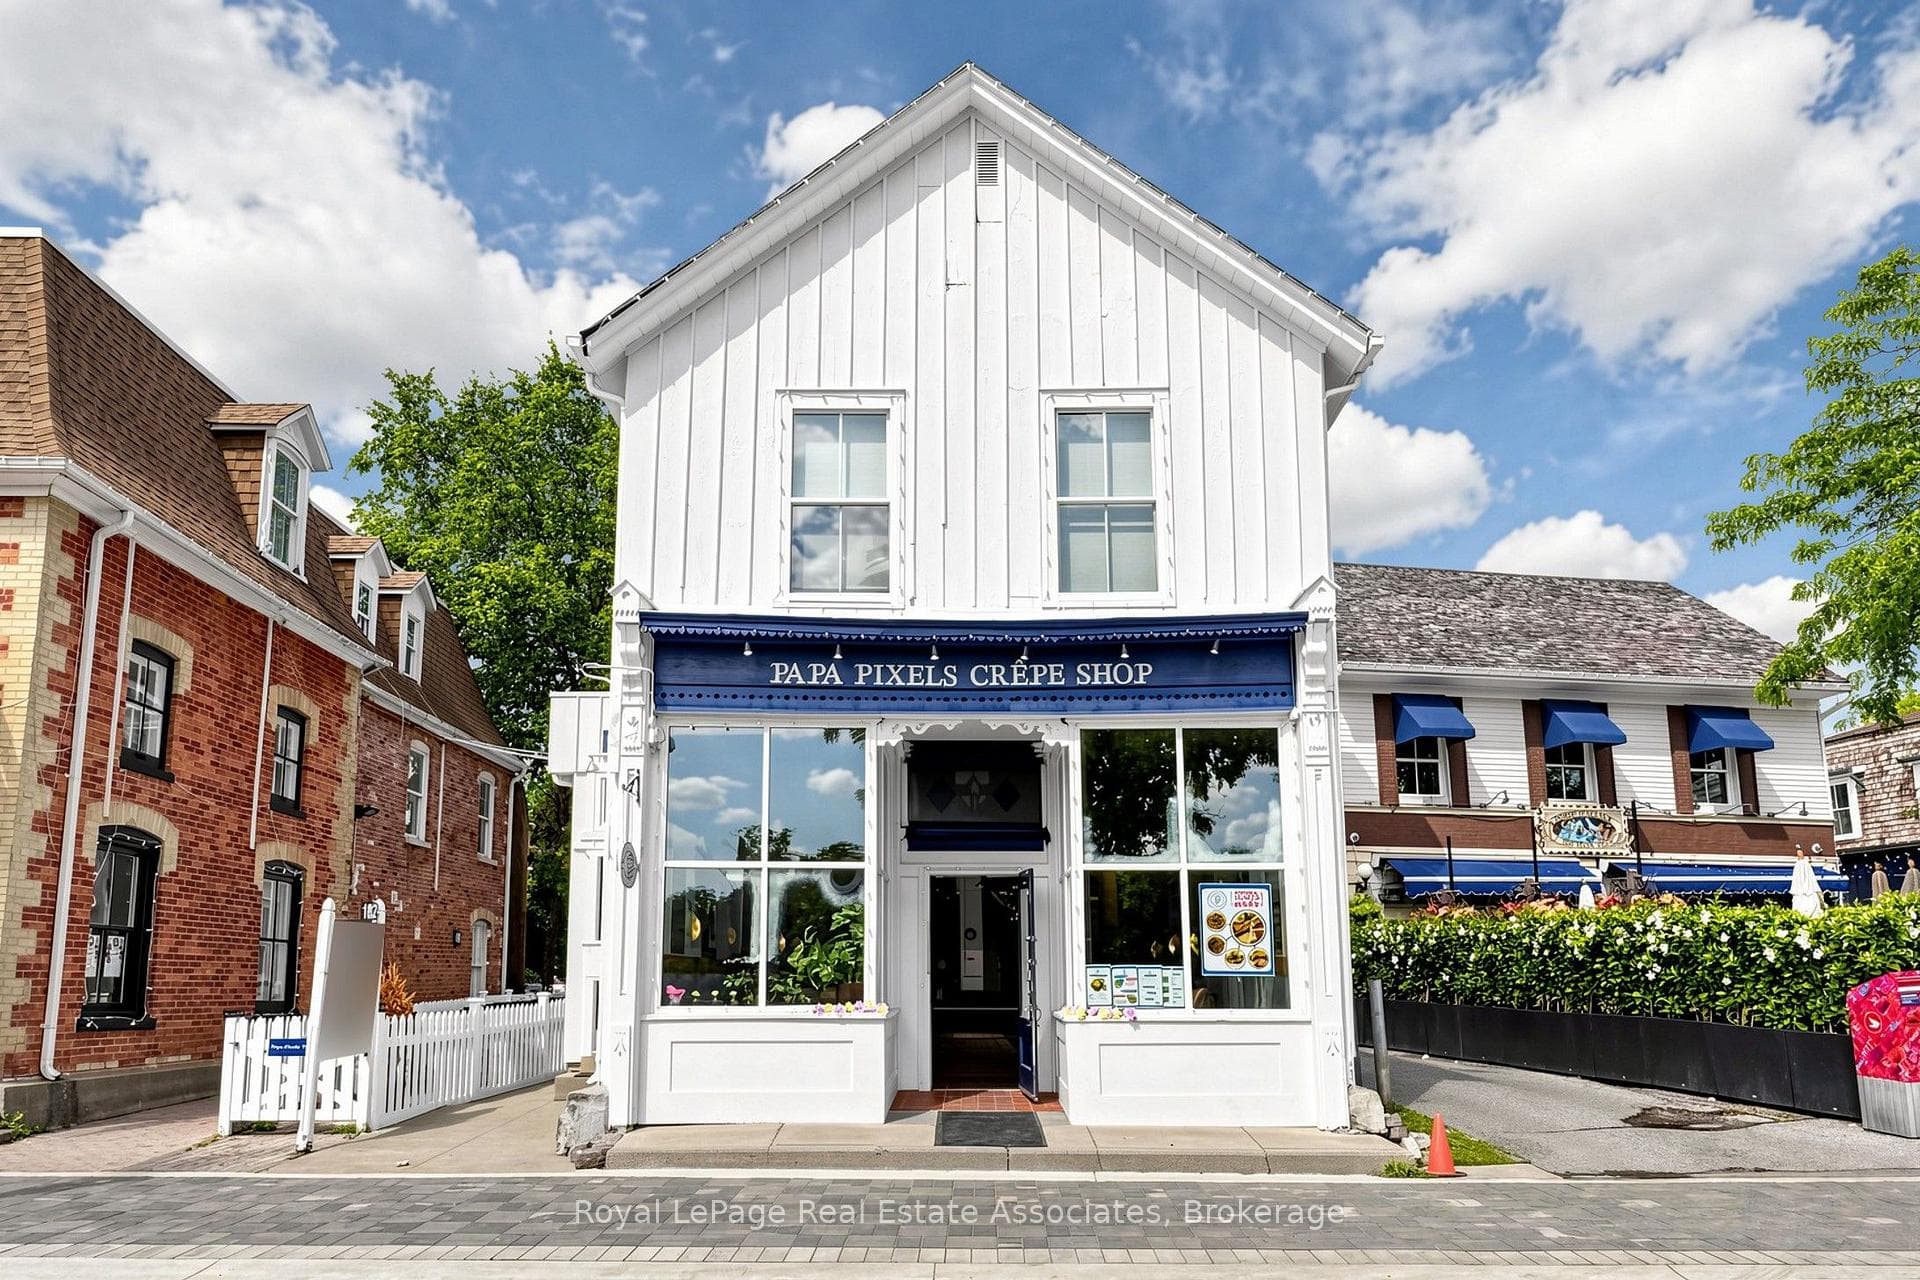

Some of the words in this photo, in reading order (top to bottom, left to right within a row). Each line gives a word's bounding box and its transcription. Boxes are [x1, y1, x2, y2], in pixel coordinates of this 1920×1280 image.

[770, 662, 843, 685] PAPA
[854, 663, 957, 687] PIXELS
[970, 659, 1065, 685] CRÊPE
[1076, 662, 1152, 685] SHOP
